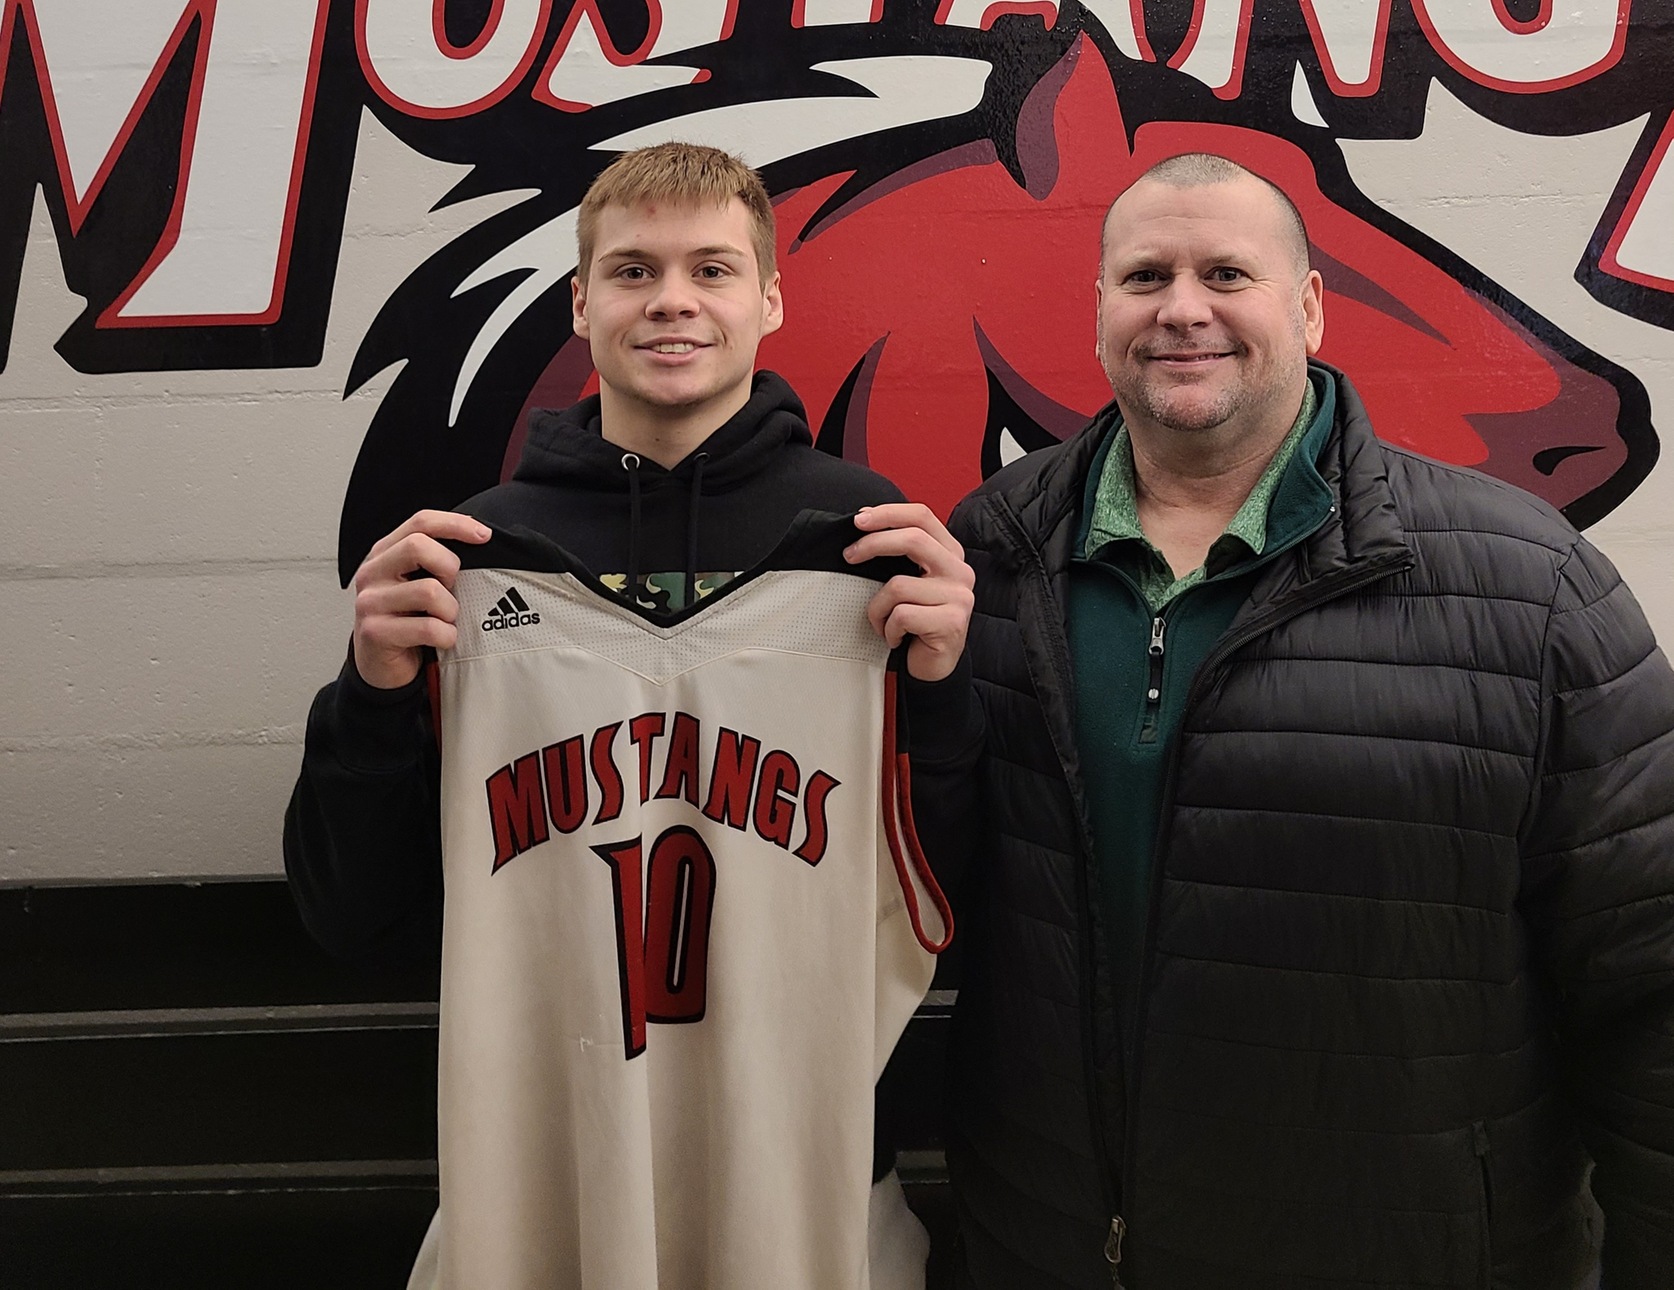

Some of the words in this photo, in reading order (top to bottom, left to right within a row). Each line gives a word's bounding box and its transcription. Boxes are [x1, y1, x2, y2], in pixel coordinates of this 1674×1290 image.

[482, 612, 541, 632] adidas
[485, 711, 842, 876] MUSTANGS
[589, 824, 718, 1061] 10
